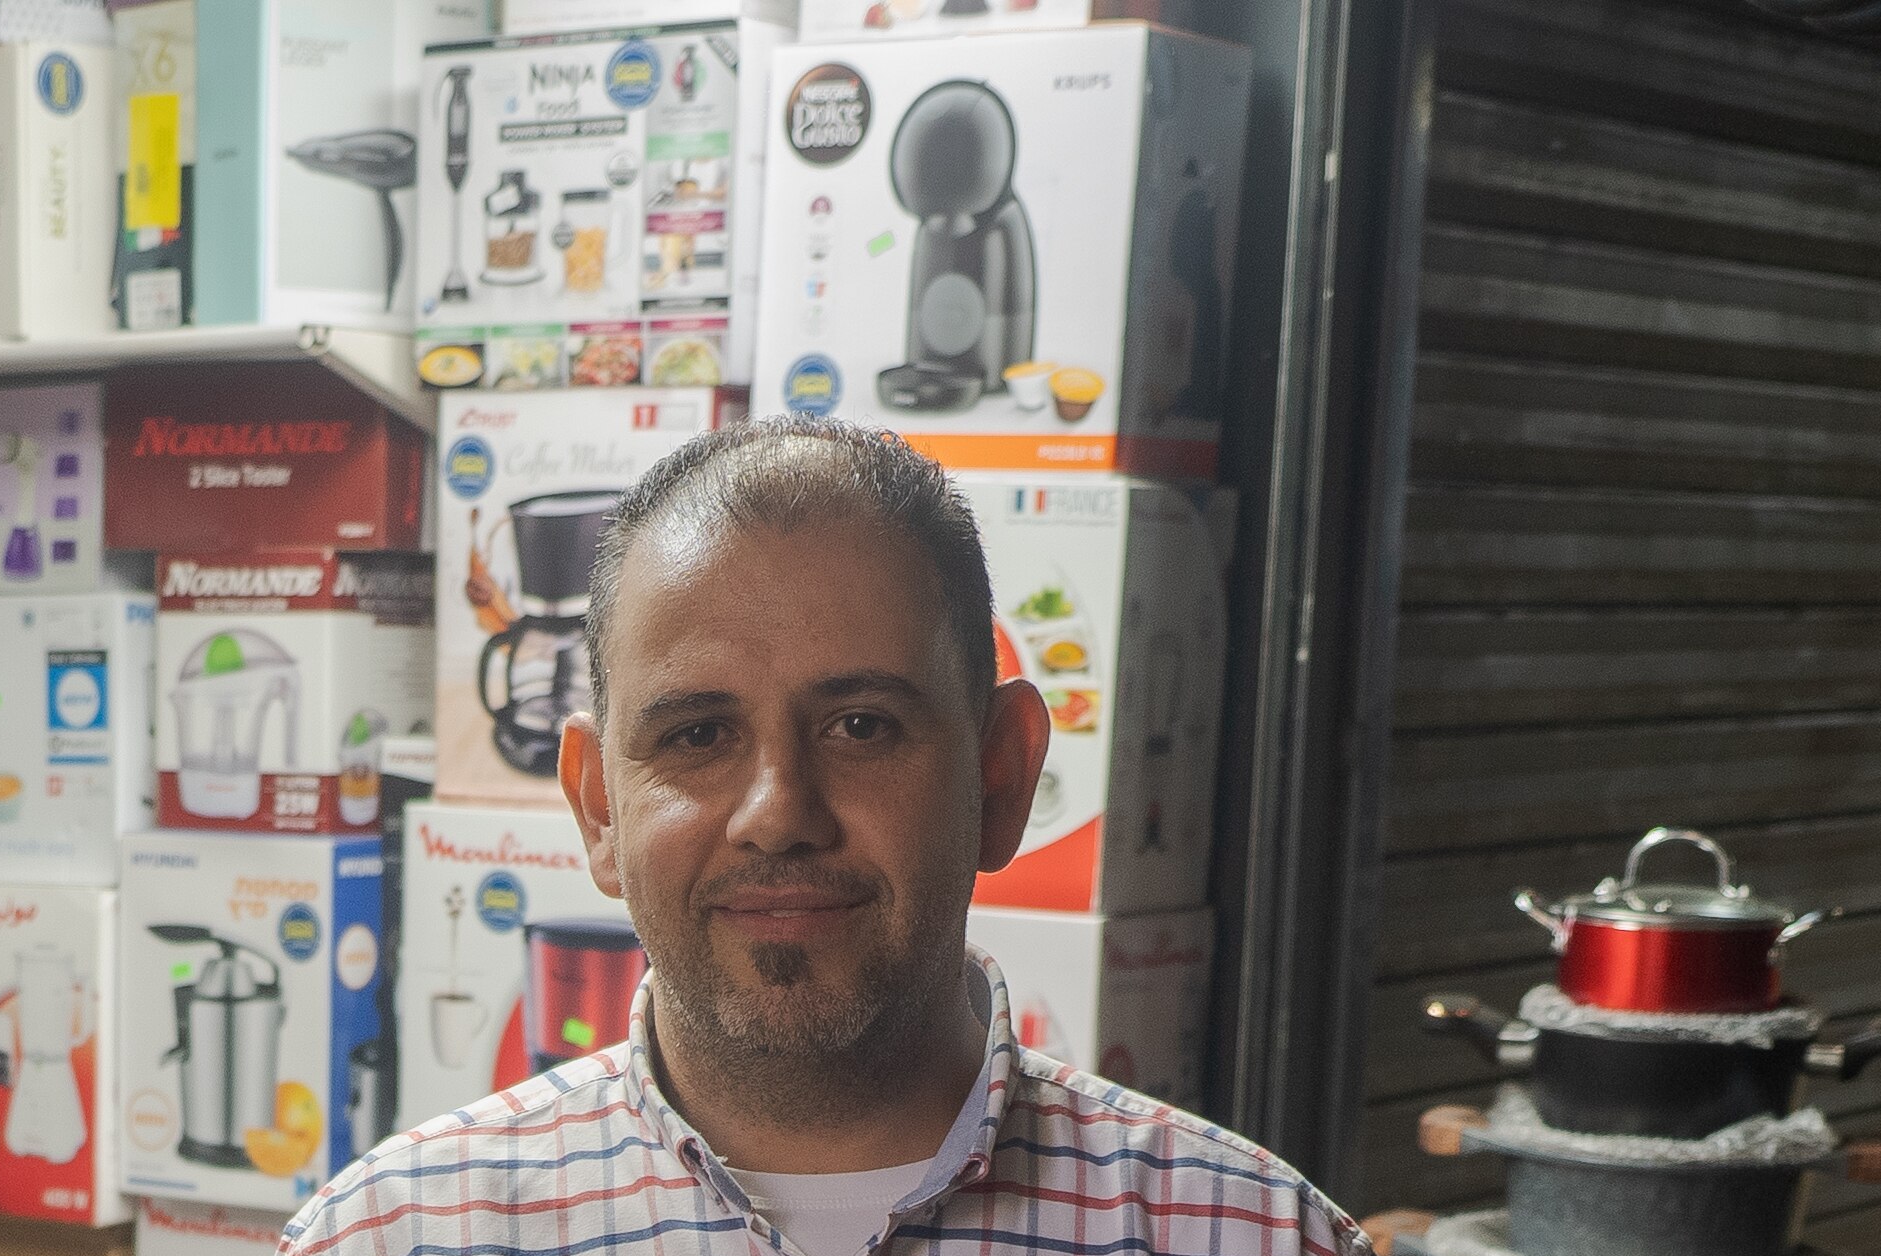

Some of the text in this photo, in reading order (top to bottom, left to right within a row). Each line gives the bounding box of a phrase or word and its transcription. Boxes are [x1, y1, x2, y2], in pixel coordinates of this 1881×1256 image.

[527, 63, 595, 97] NINJA
[1053, 73, 1112, 91] KRUPS
[793, 101, 864, 128] Dolce
[792, 122, 863, 150] Gusto
[49, 145, 67, 239] BEAUTY
[136, 417, 352, 457] NORMANDE
[163, 561, 324, 597] NORMANDE
[418, 823, 587, 870] Moulinex
